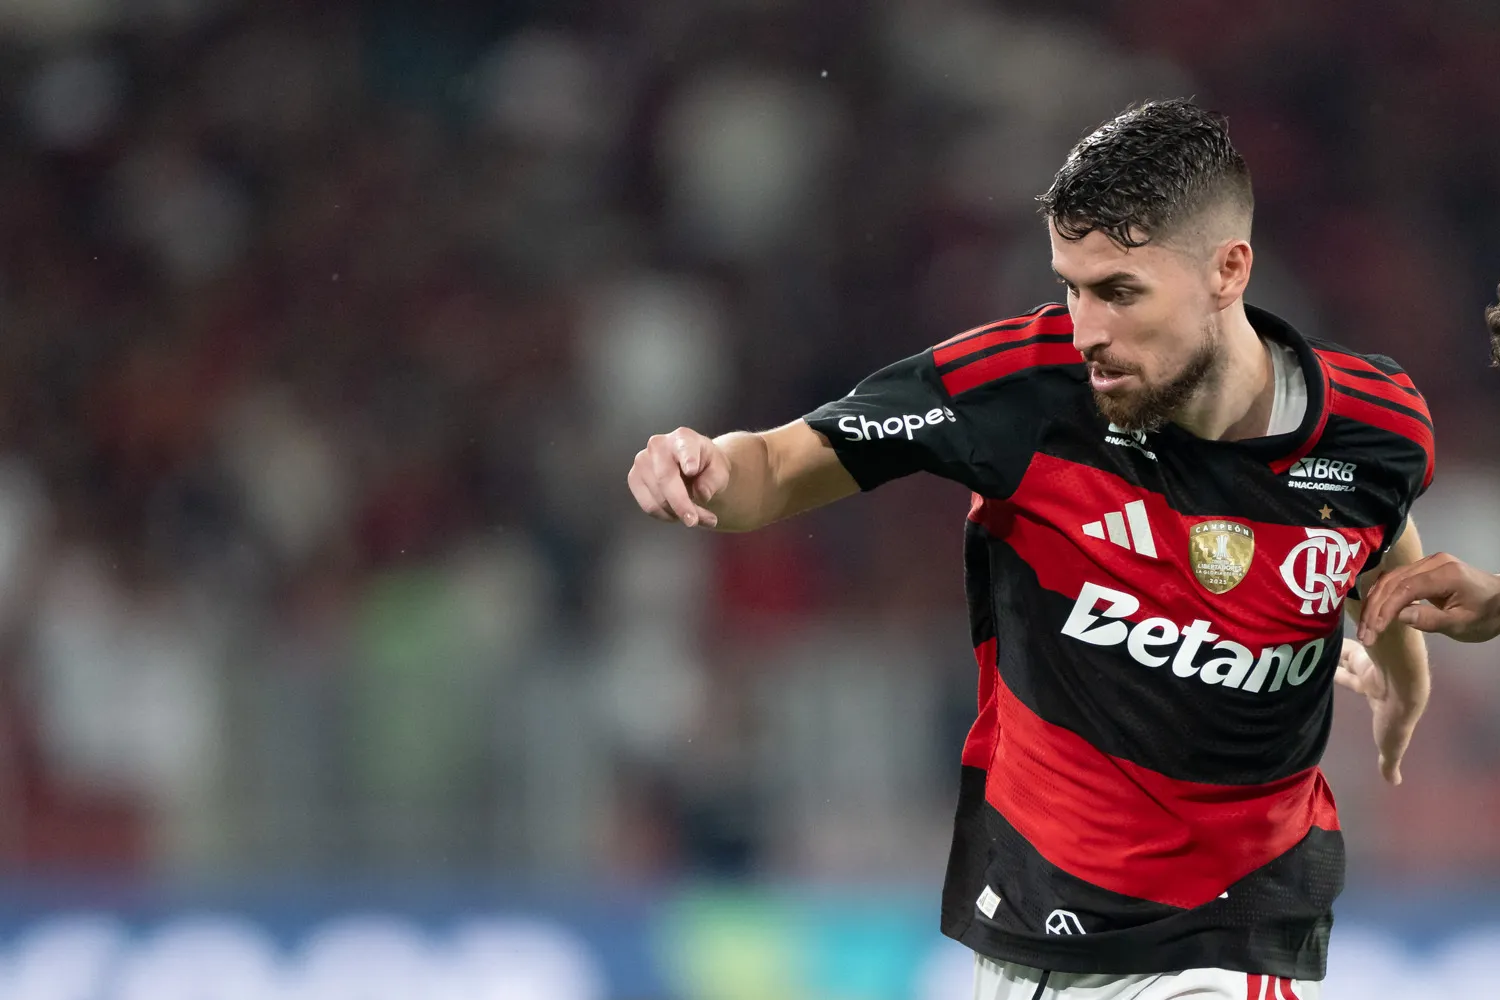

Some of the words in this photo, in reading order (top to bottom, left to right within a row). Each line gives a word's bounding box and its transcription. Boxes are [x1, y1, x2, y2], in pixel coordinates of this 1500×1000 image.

[838, 405, 957, 441] Shopee
[1313, 457, 1357, 482] BRB
[1195, 523, 1249, 536] CAMPEÓN
[1060, 581, 1325, 693] Betano
